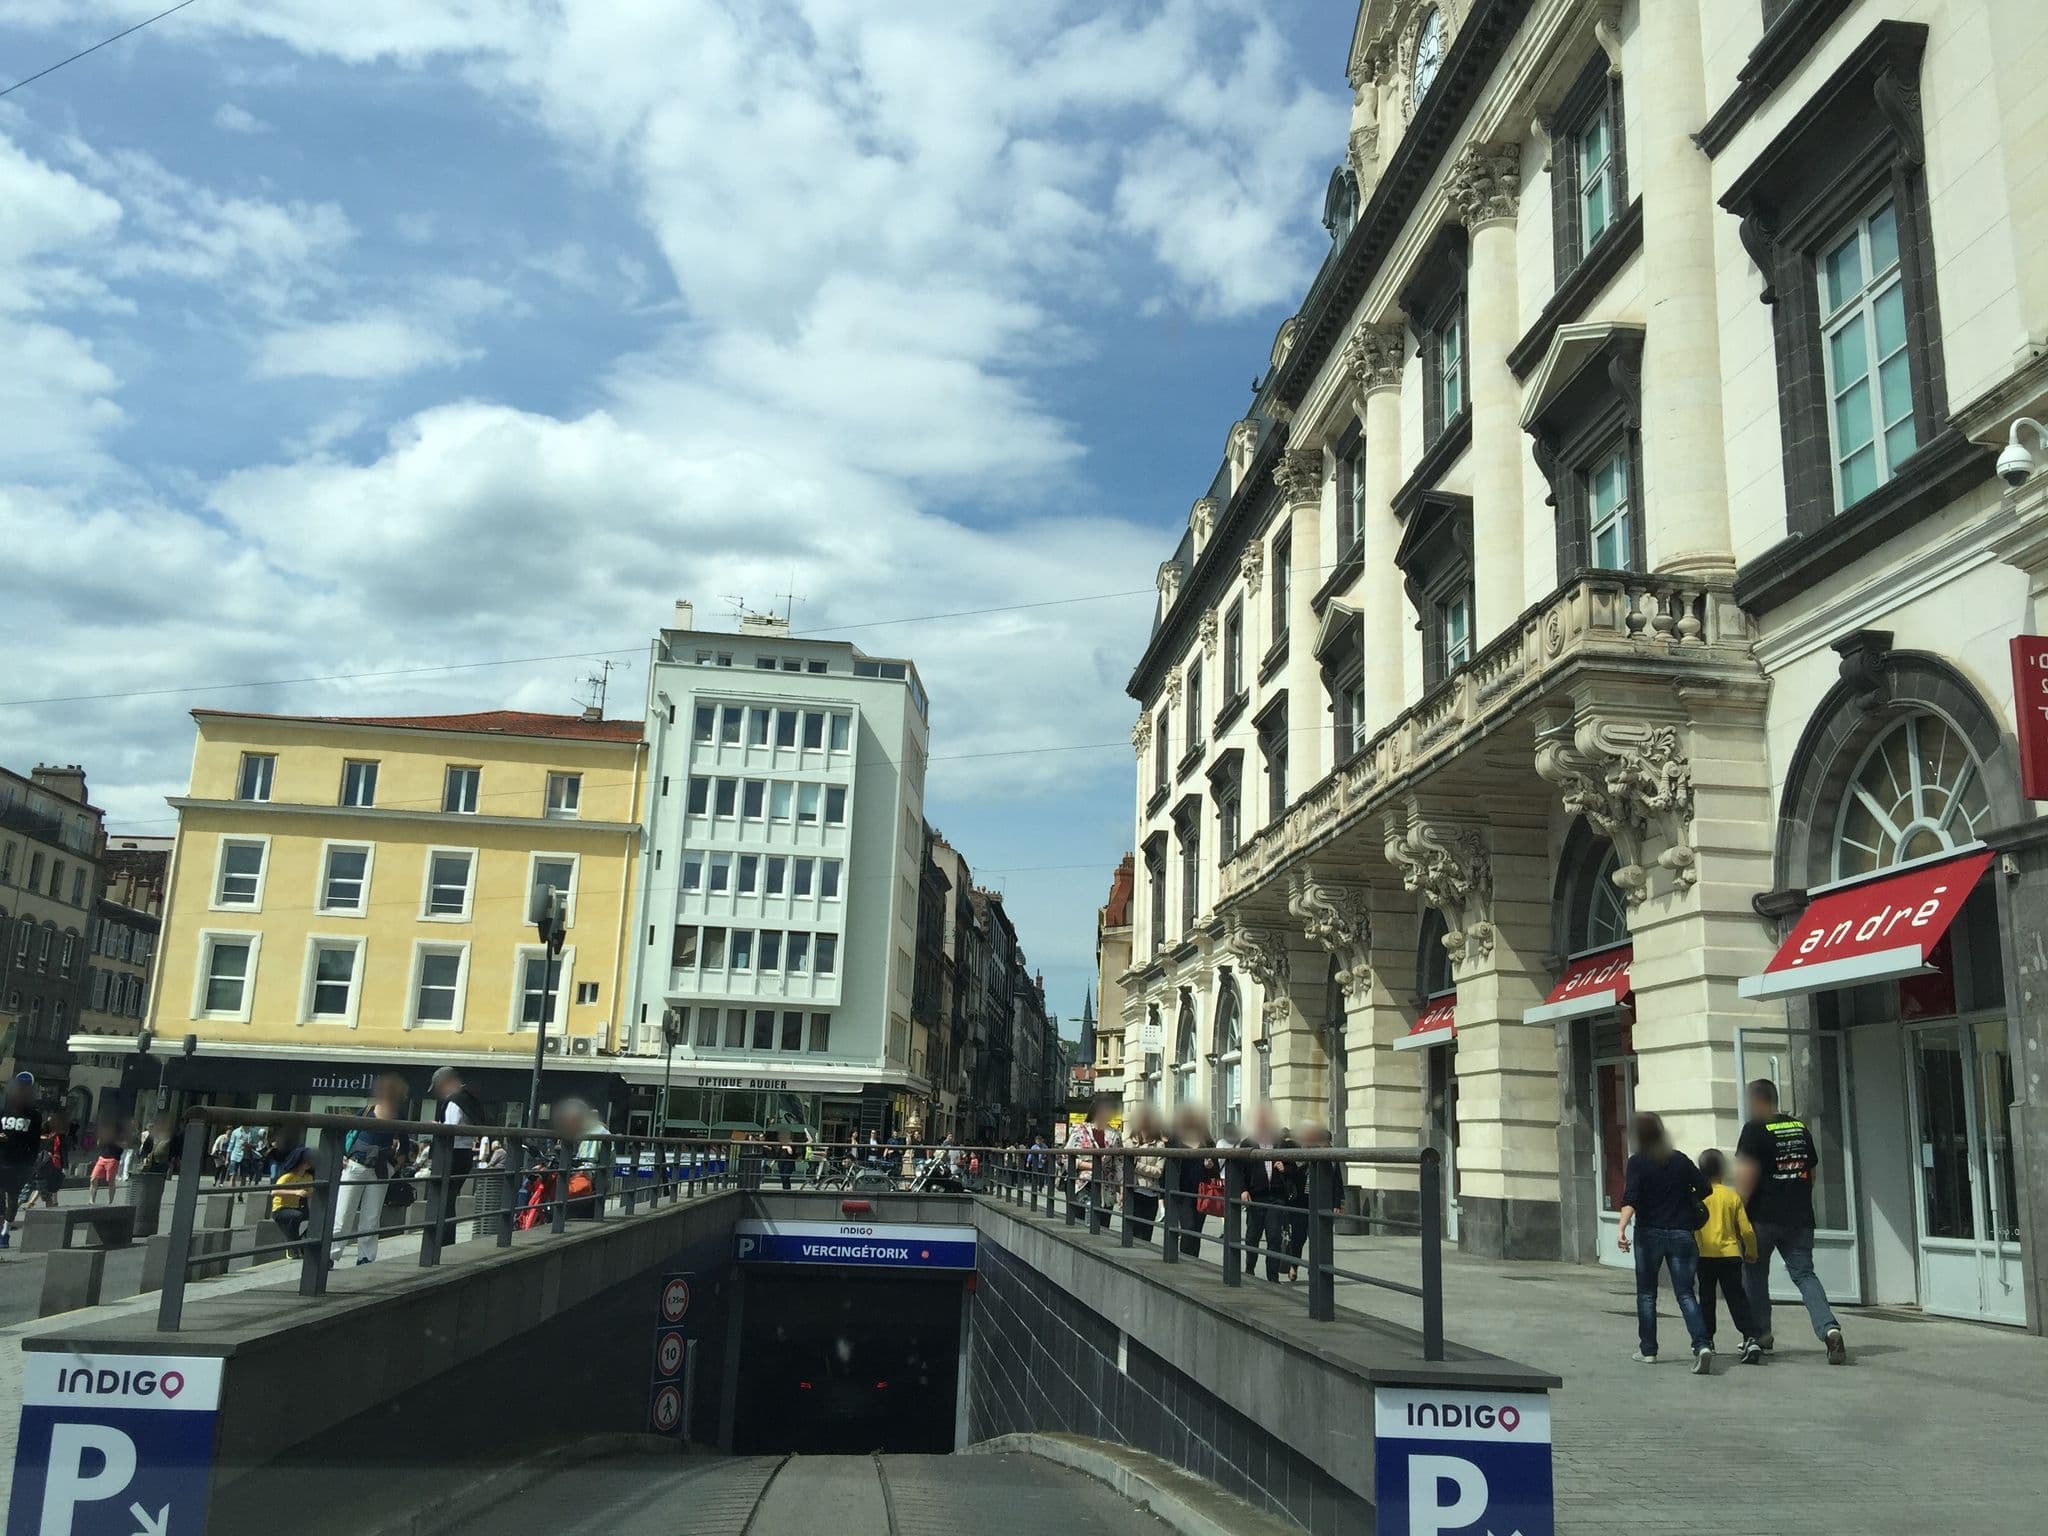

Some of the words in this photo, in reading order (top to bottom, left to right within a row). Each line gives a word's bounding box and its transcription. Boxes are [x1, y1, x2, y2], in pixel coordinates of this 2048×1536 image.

[698, 1077, 742, 1088] OPTIQUE
[840, 1226, 873, 1236] INDIGO
[738, 1238, 755, 1258] P
[802, 1244, 908, 1260] VERCINGÉTORIX
[664, 1347, 677, 1360] 10
[58, 1368, 184, 1399] INDIGO
[1407, 1402, 1520, 1432] INDIGO
[40, 1423, 137, 1536] P
[1408, 1454, 1489, 1536] P
